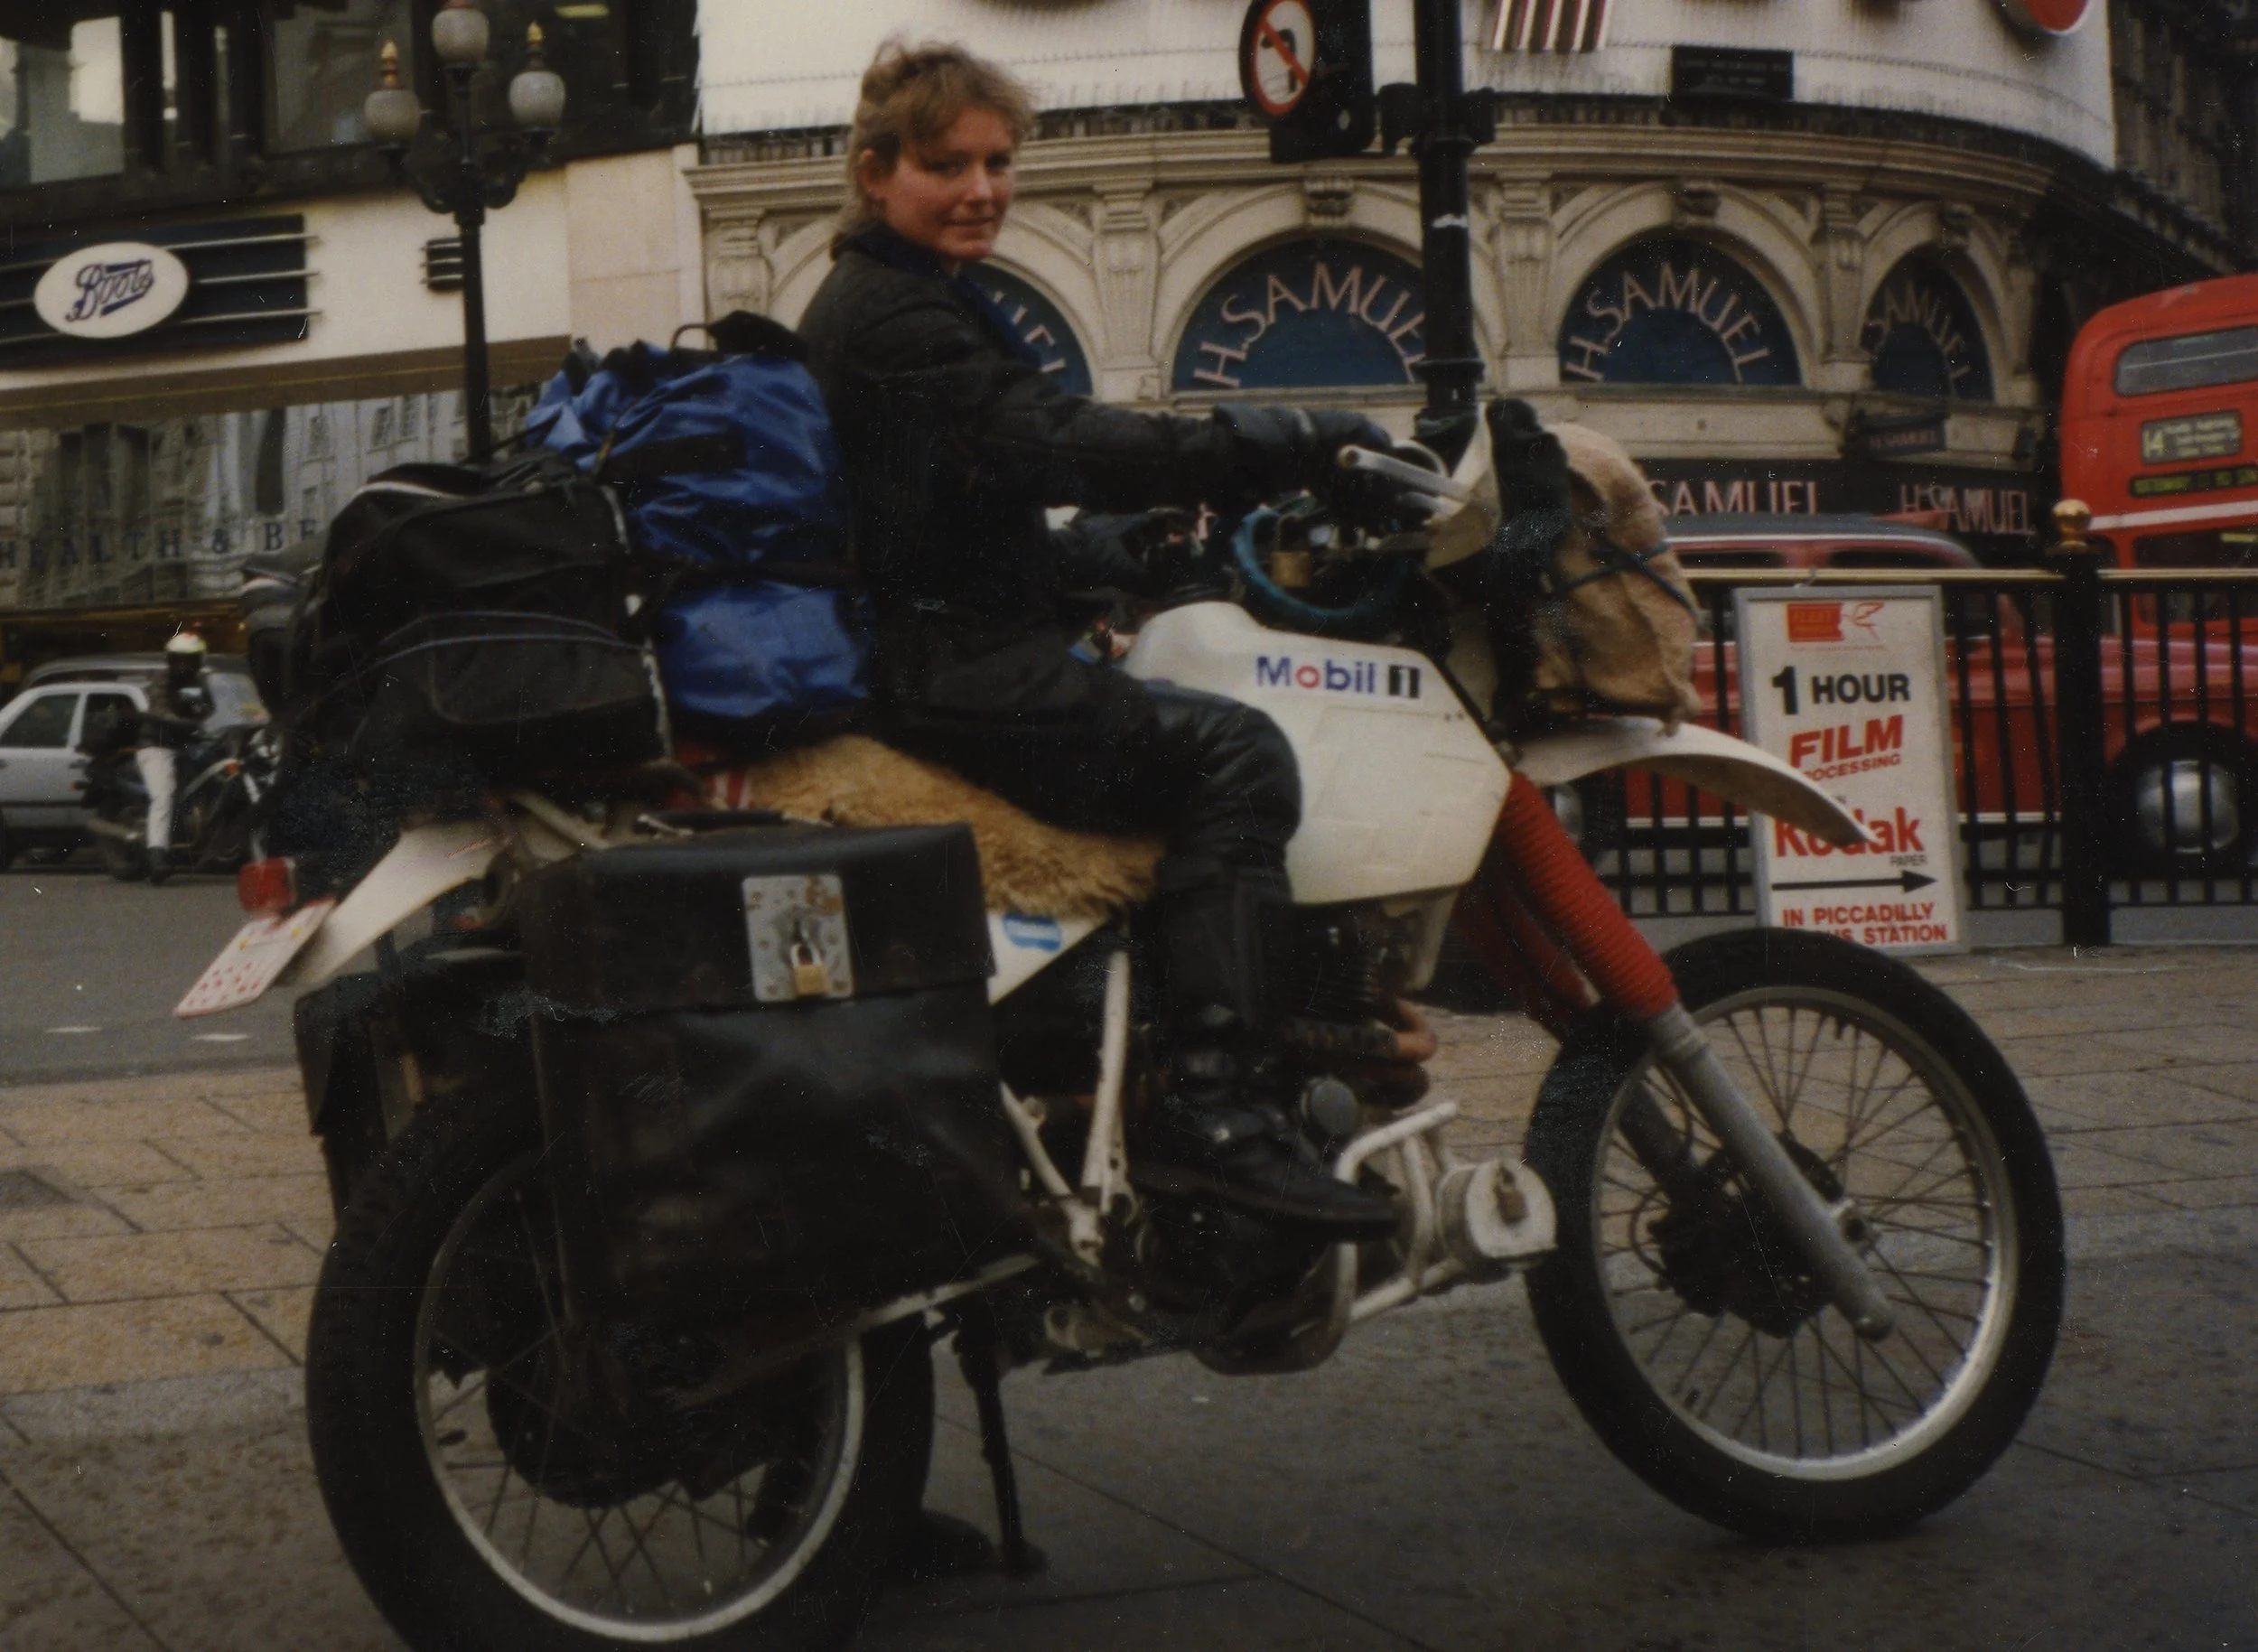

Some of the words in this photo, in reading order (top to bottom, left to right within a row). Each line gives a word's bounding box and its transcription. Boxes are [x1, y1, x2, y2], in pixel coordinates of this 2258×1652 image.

[66, 259, 154, 322] Boots
[211, 527, 227, 554] &
[1256, 656, 1376, 695] Mobil
[1771, 666, 1798, 714] 1
[1812, 674, 1910, 705] HOUR
[1789, 714, 1903, 769] FILM
[1803, 753, 1901, 782] OCESSING
[1889, 854, 1927, 866] PAPER
[1782, 909, 1804, 927] IN
[1813, 901, 1935, 925] PICCADILLY
[1863, 925, 1947, 944] STATION
